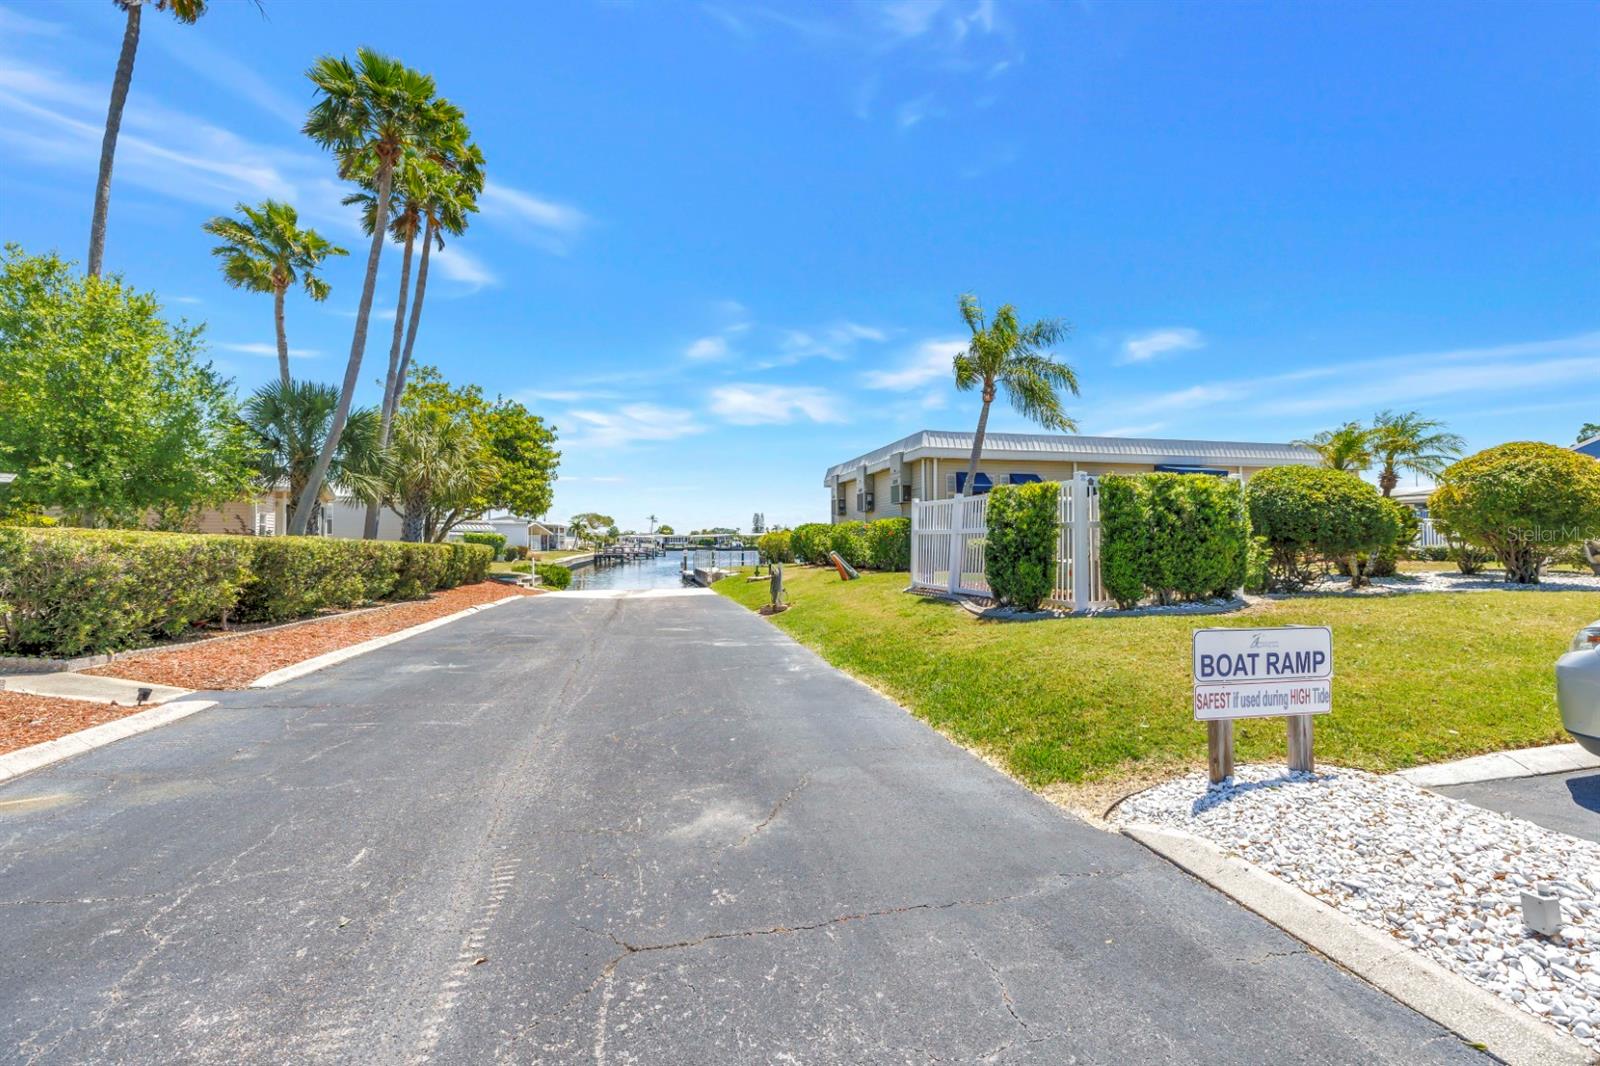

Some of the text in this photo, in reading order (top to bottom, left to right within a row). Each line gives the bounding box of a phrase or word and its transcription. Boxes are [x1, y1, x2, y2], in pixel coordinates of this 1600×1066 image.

[1200, 650, 1326, 677] BOAT RAMP
[1196, 687, 1329, 710] SAFEST if used during HIGH Tide
